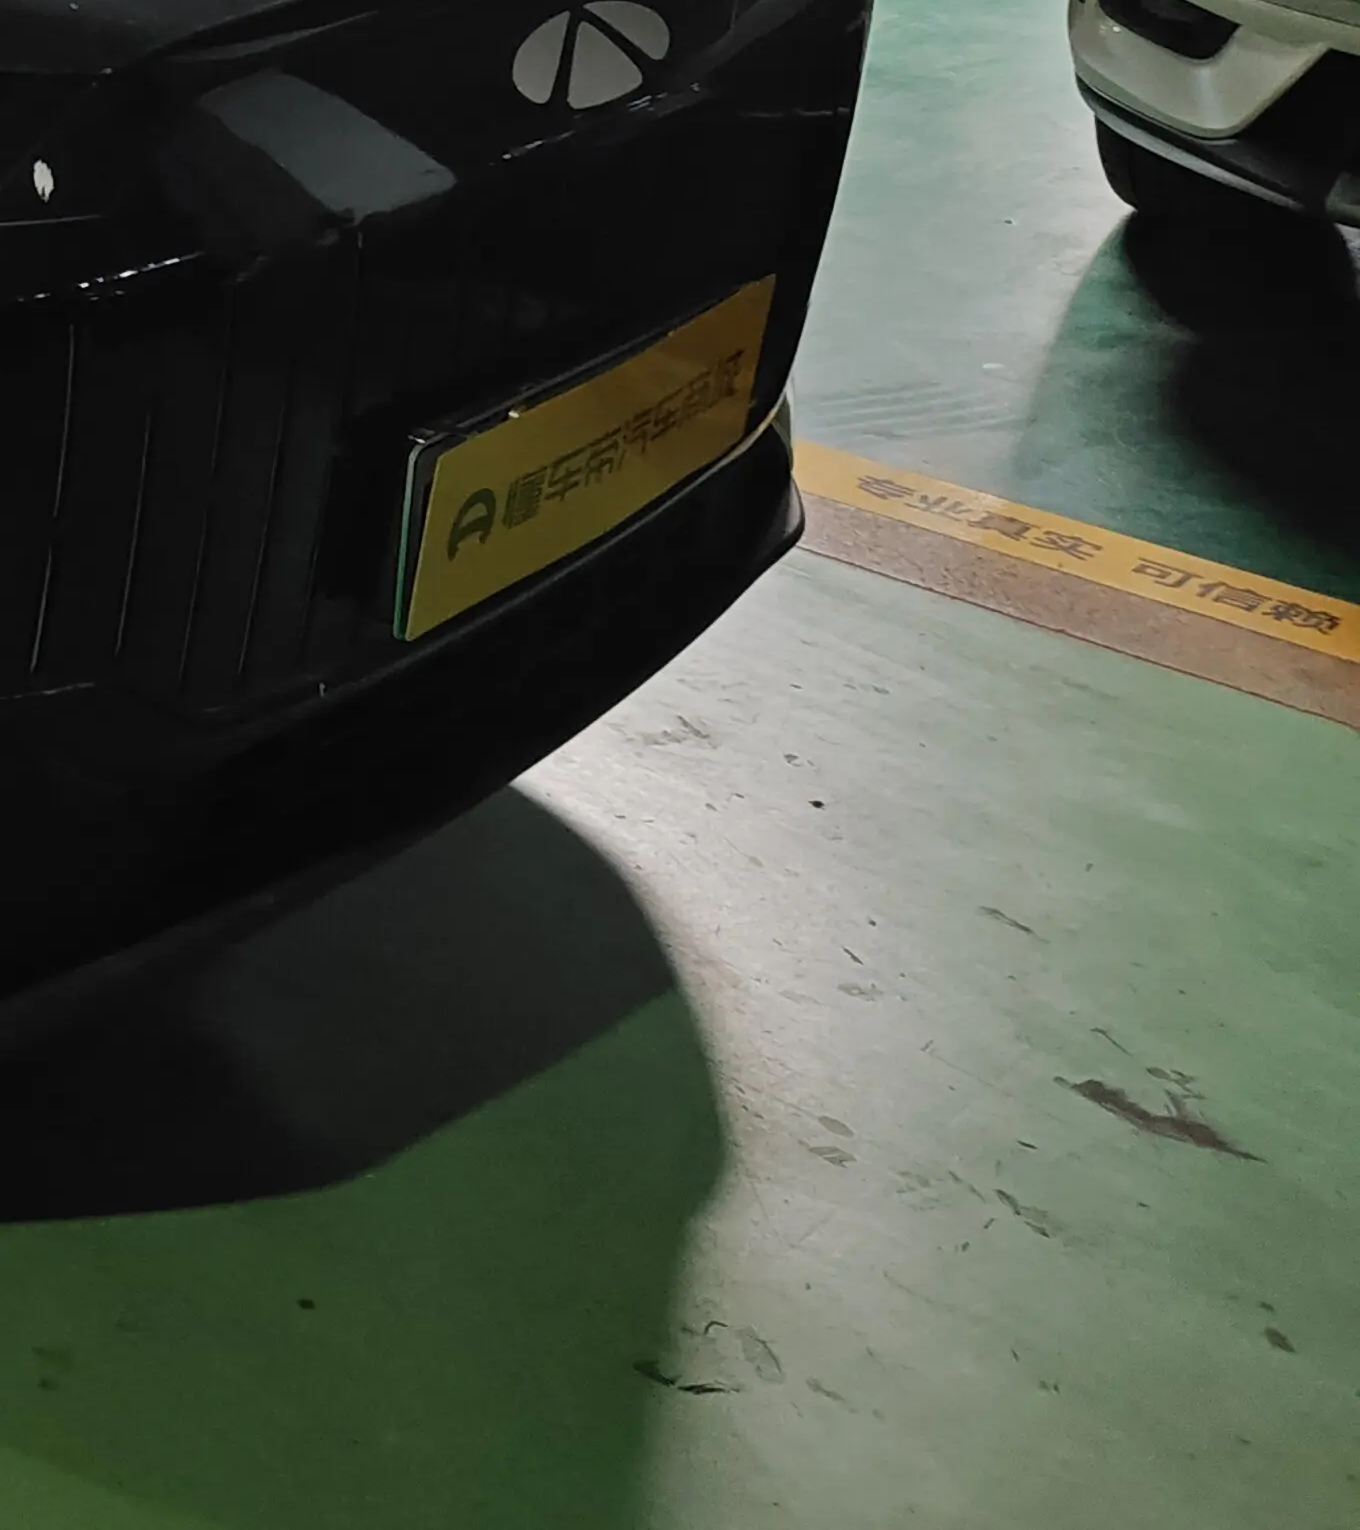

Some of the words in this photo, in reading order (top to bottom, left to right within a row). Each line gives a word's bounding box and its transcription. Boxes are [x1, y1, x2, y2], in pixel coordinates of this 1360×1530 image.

[856, 474, 1104, 561] 专业真实
[1130, 557, 1341, 636] 可信赖
